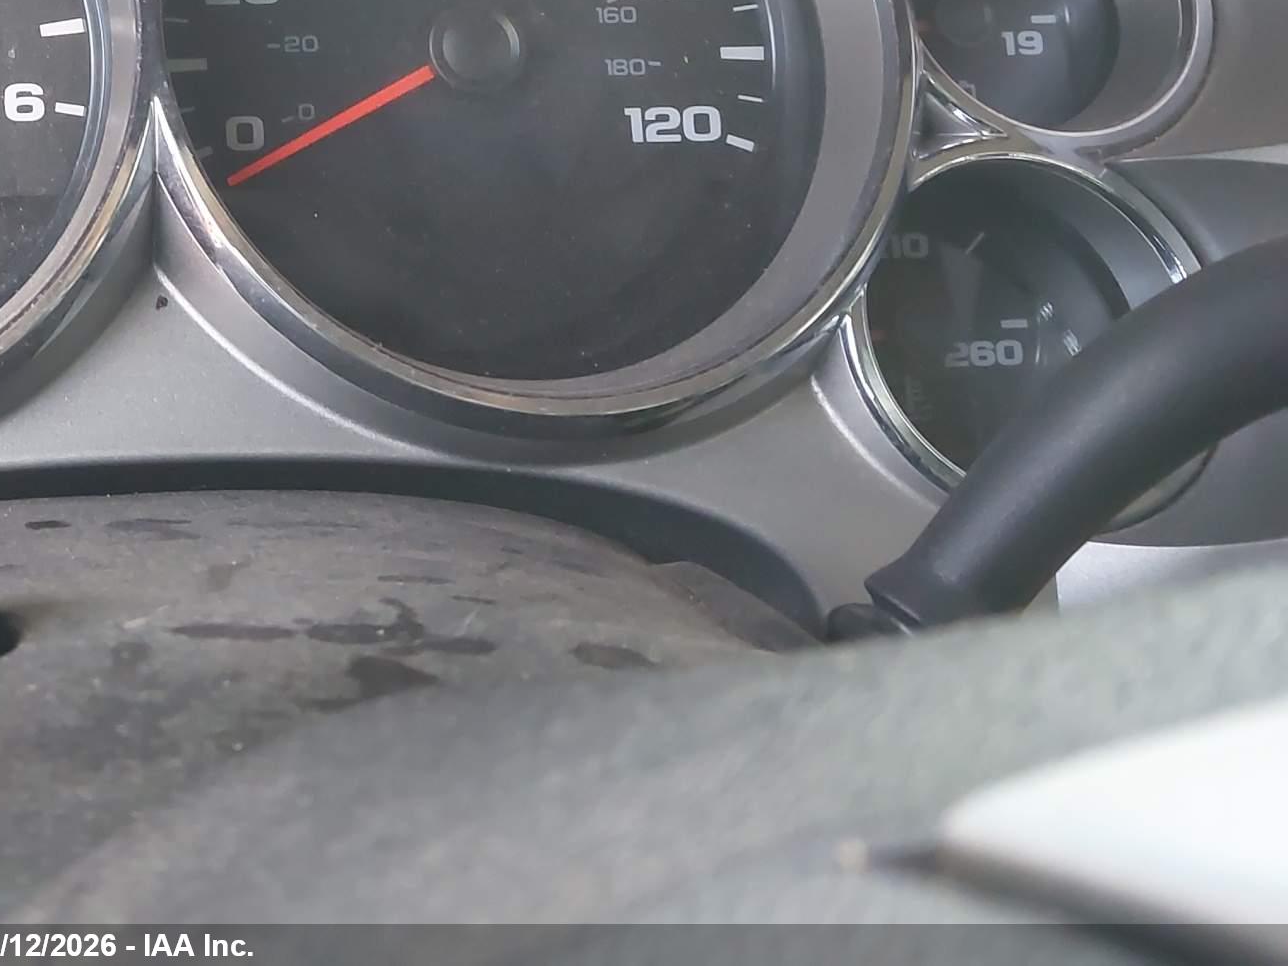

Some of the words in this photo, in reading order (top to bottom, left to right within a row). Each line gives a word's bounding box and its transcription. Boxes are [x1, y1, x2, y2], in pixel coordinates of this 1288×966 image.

[595, 6, 637, 24] 160
[284, 35, 319, 53] 20
[1001, 30, 1044, 55] 19
[604, 58, 646, 76] 180
[3, 83, 45, 122] 6
[225, 116, 265, 151] 0
[624, 106, 722, 143] 120
[944, 339, 1024, 369] 260
